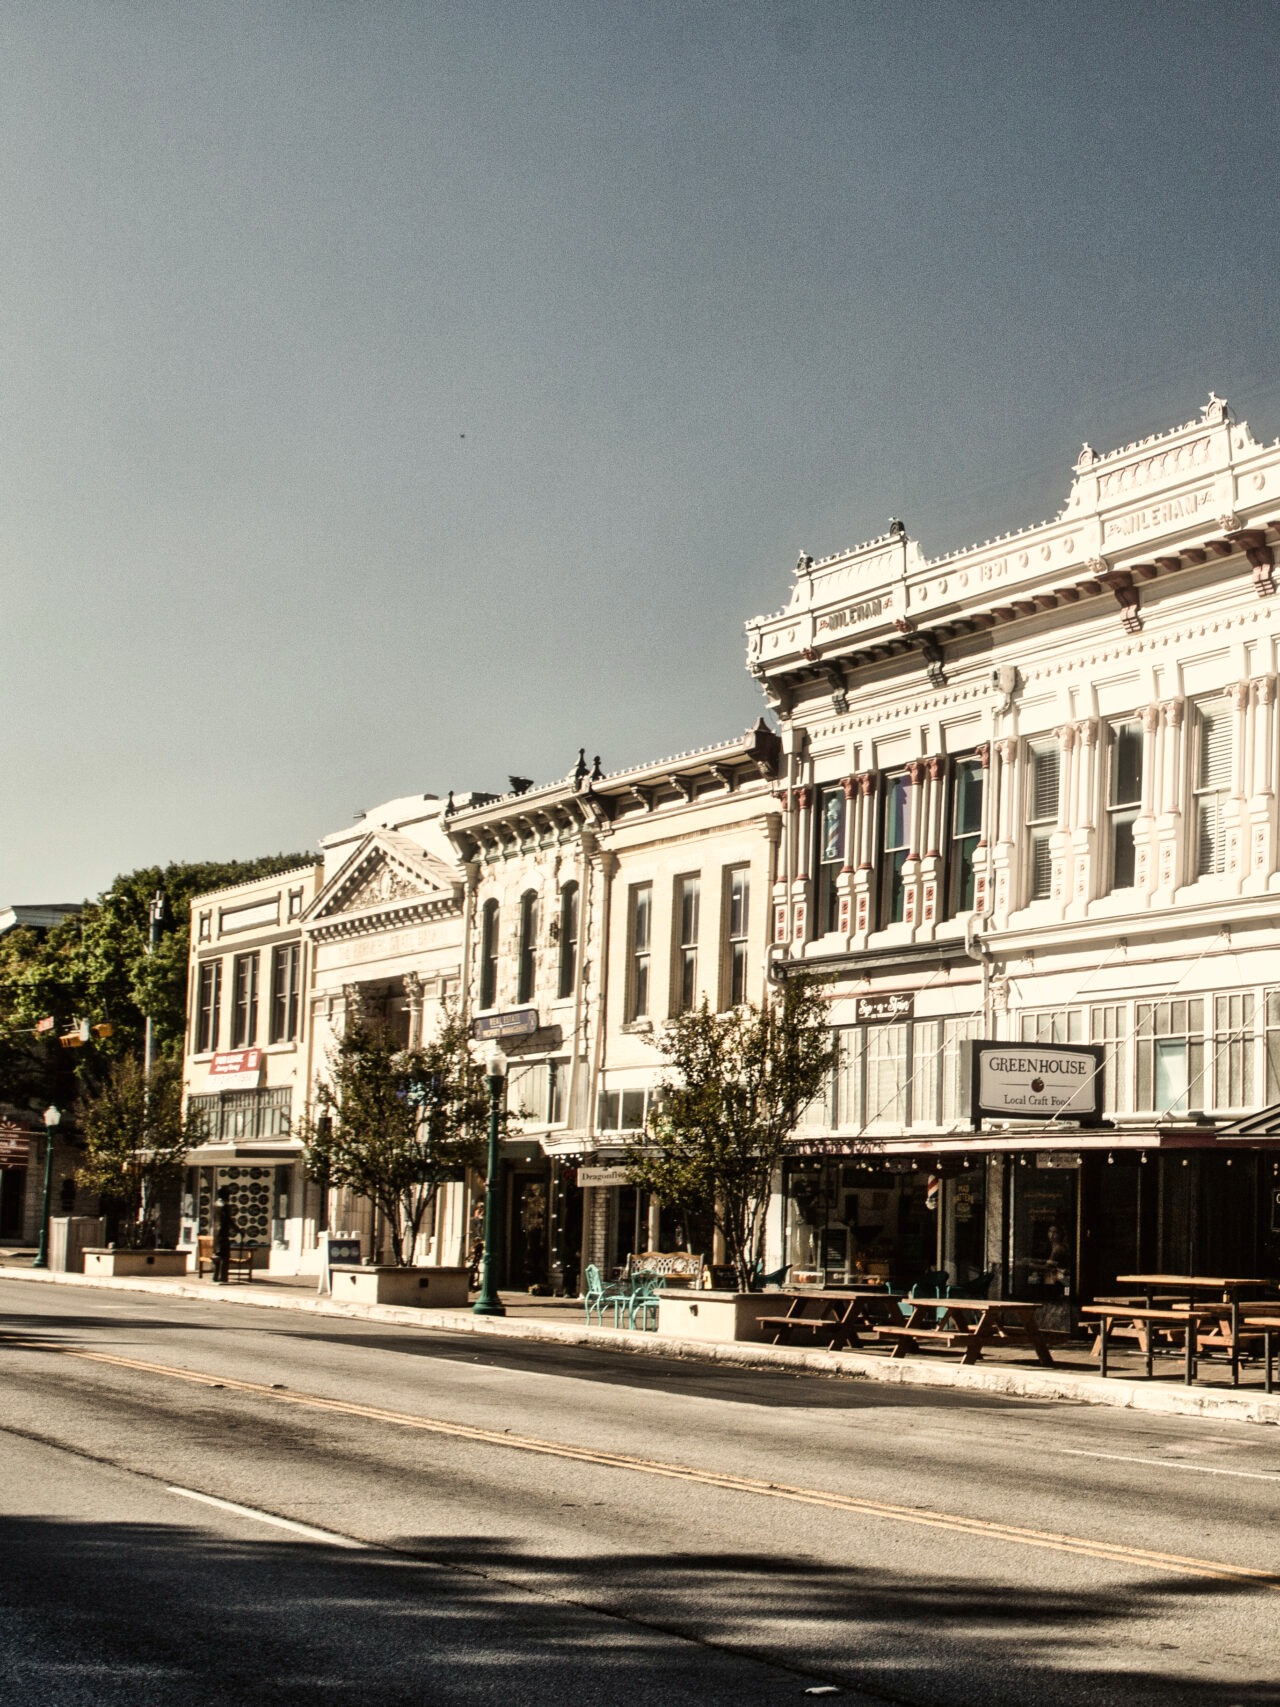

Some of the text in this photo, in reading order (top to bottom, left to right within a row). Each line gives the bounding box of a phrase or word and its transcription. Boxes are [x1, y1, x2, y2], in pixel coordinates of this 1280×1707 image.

[1122, 495, 1198, 536] MILEHAM
[980, 558, 1007, 582] 1891
[829, 598, 882, 631] MILEHAM
[989, 1057, 1087, 1074] GREENHOUSE
[1004, 1094, 1071, 1107] Local Craft Food
